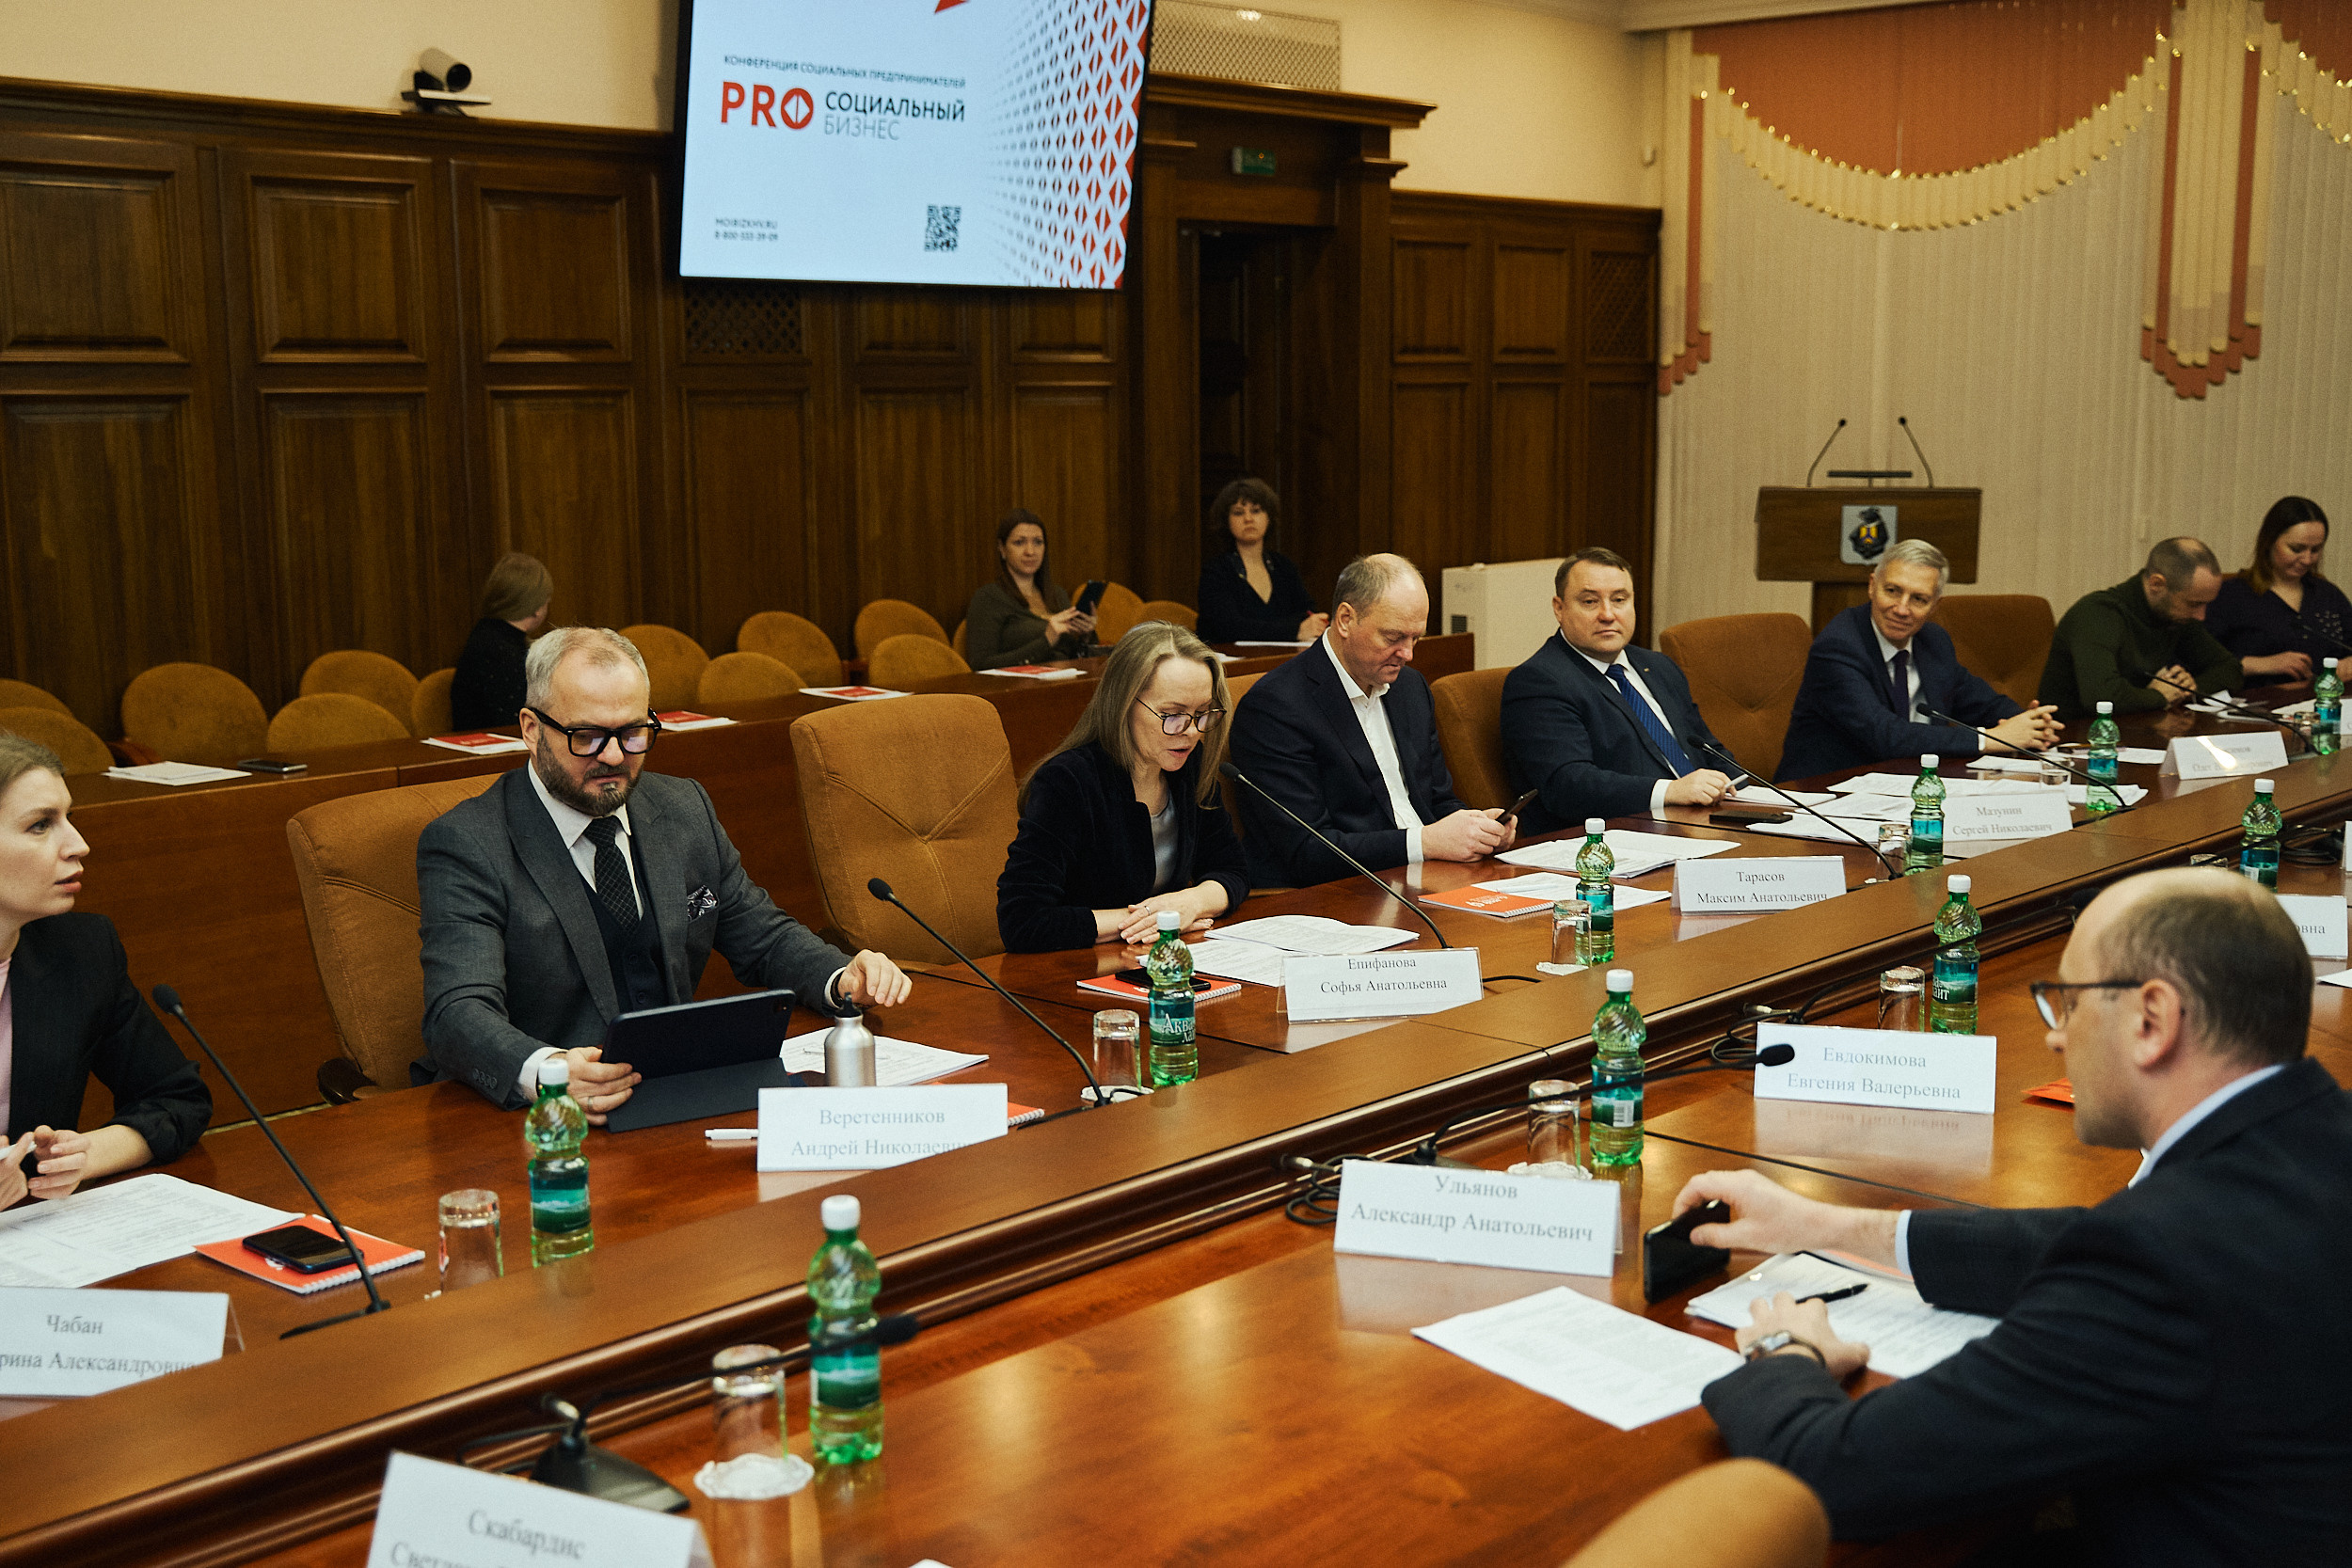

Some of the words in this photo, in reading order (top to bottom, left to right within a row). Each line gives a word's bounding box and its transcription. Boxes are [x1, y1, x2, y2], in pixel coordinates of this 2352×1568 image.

[723, 55, 798, 71] КОНФЕРЕНЦИЯ
[801, 62, 866, 79] СОЦИАЛЬНЫХ
[869, 70, 966, 89] ПРЕДПРИНИМАТЕЛЕЙ
[721, 81, 815, 130] PRO
[825, 90, 965, 122] СОЦИАЛЬНЫЙ
[823, 113, 900, 141] БИЗНЕС
[1952, 824, 1989, 836] Сергей
[1736, 871, 1785, 884] Тарасов
[1697, 893, 1745, 904] Максим
[1749, 892, 1828, 903] Анатольевич
[1348, 958, 1417, 972] Епифанова
[1320, 981, 1362, 995] Софья
[1366, 979, 1448, 992] Анатольевна
[1823, 1047, 1927, 1069] Евдокимова
[1788, 1073, 1855, 1092] Евгения
[1862, 1078, 1962, 1100] Валерьевна
[819, 1109, 946, 1129] Веретенников
[791, 1139, 858, 1160] Андрей
[1435, 1175, 1518, 1199] Ульянов
[1351, 1202, 1456, 1229] Александр
[1462, 1212, 1593, 1242] Анатольевич
[47, 1314, 103, 1335] Чабан
[469, 1509, 587, 1560] Скабардис
